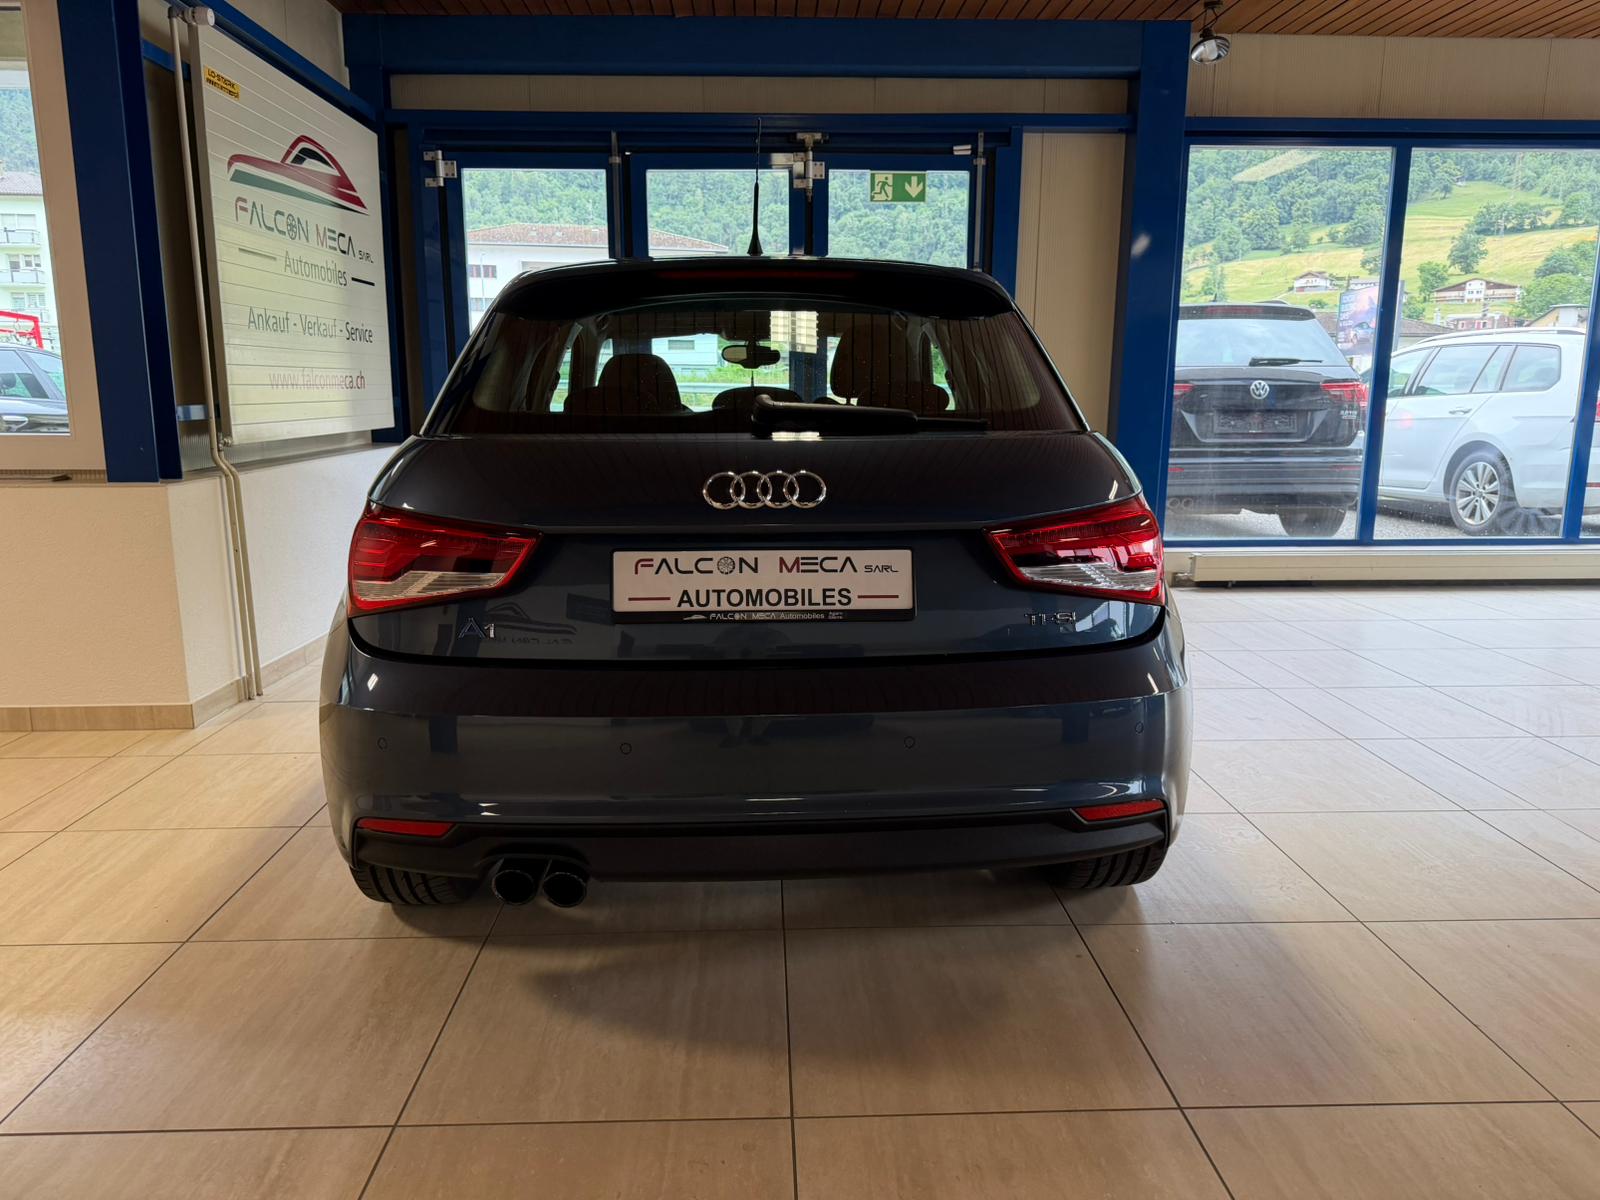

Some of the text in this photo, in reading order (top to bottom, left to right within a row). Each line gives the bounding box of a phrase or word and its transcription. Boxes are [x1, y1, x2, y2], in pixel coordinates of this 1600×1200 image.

[234, 196, 310, 243] FALCON
[315, 223, 356, 258] MECA
[283, 250, 348, 287] Automobiles
[247, 306, 290, 334] Ankauf
[299, 313, 338, 339] Verkauf
[345, 321, 374, 344] Service
[268, 367, 366, 391] www.falconmeca.ch
[634, 556, 899, 575] FALCON MECA SARL
[677, 588, 852, 608] AUTOMOBILES
[780, 612, 825, 620] Automobiles
[458, 617, 496, 639] A1
